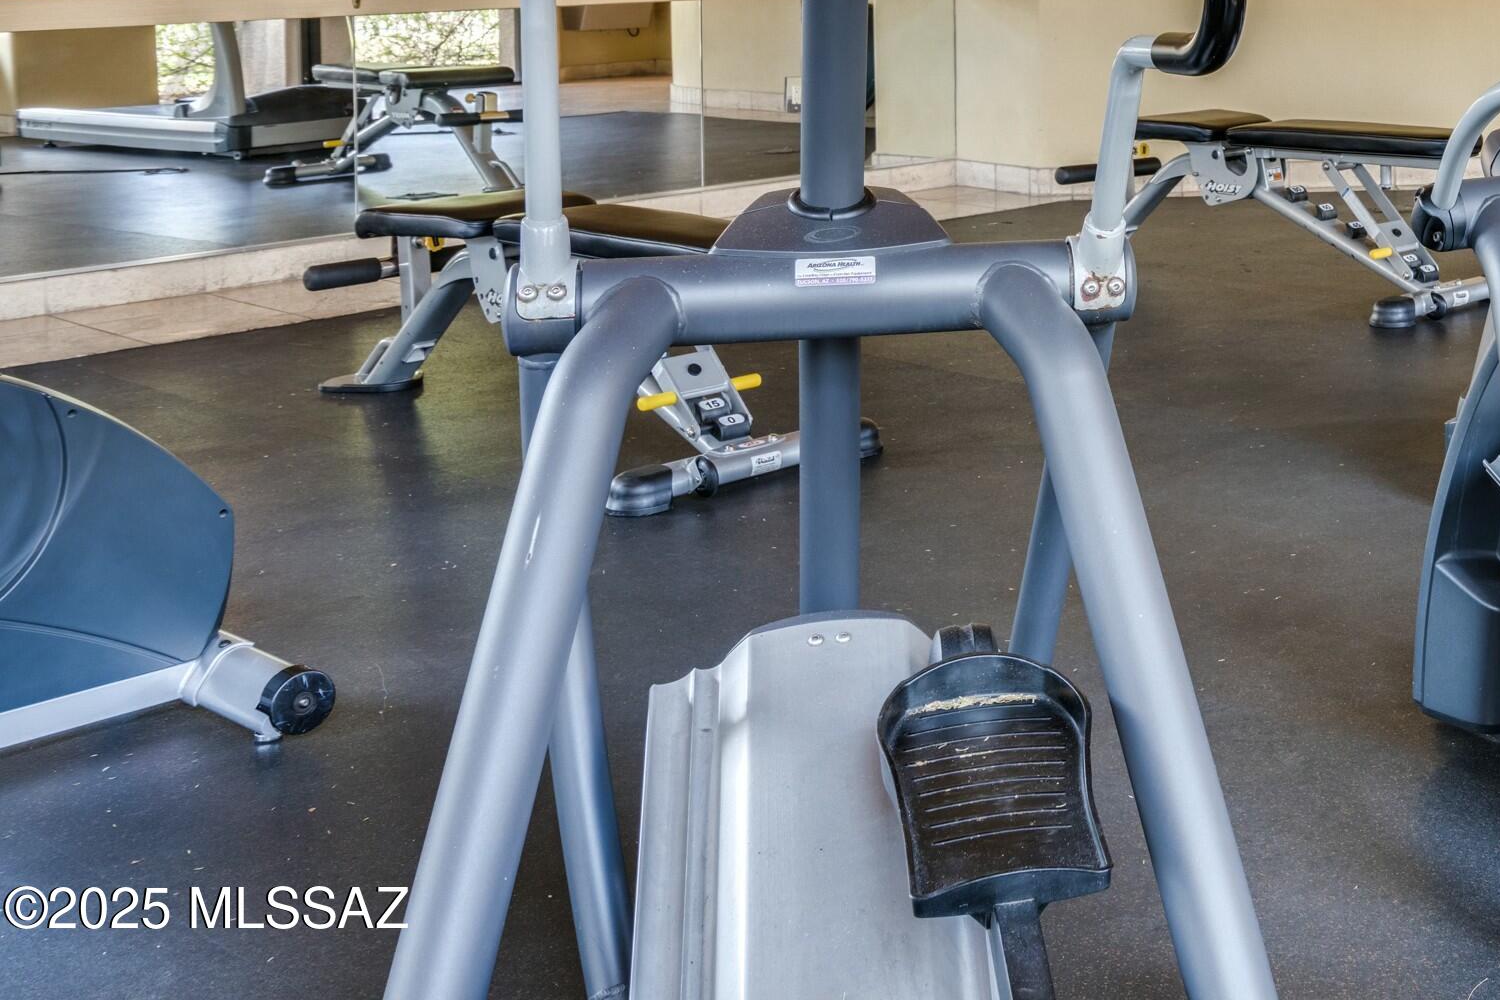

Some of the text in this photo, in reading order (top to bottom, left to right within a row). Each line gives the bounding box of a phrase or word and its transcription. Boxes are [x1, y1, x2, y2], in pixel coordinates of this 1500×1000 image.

[1206, 182, 1242, 194] HOIST
[705, 400, 721, 409] 15
[727, 416, 736, 424] 0
